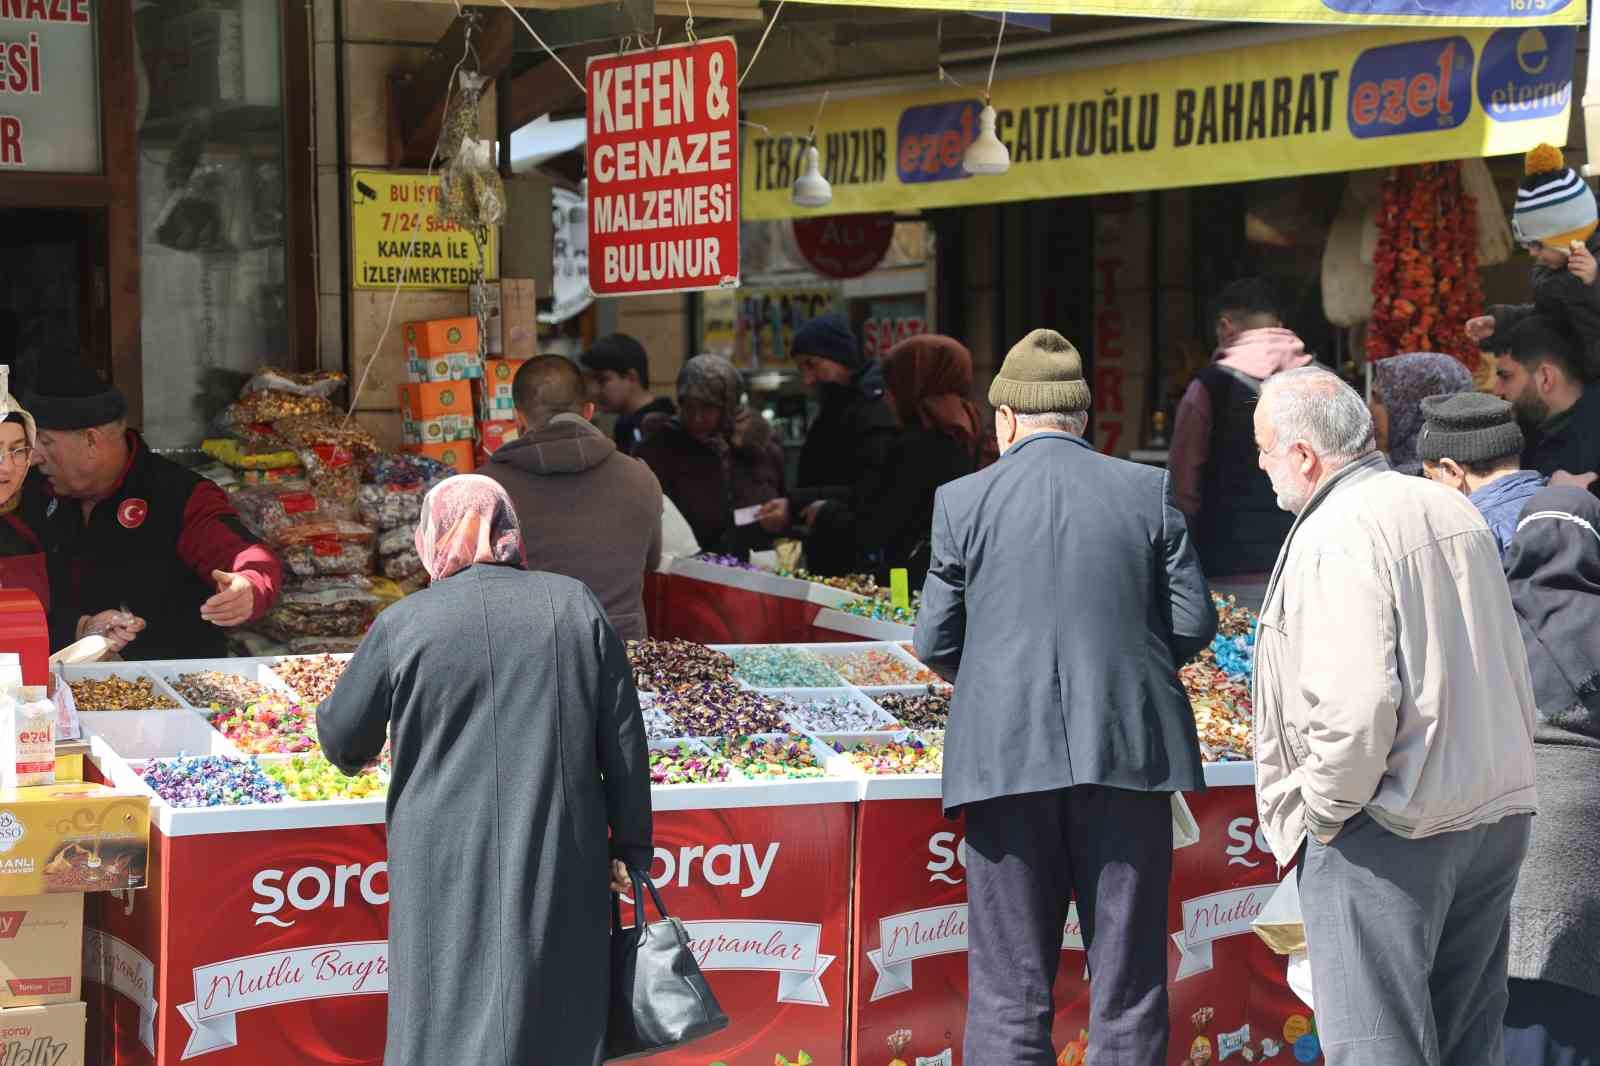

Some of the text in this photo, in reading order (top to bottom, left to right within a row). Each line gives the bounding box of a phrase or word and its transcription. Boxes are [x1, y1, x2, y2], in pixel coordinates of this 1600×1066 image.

[592, 51, 730, 135] KEFEN &
[1173, 71, 1339, 147] BAHARAT
[1351, 41, 1457, 126] ezel
[593, 129, 732, 183] CENAZE
[824, 129, 886, 185] HIZIR
[390, 184, 409, 202] BU
[378, 236, 468, 259] KAMERA İLE
[381, 212, 420, 234] 7/24
[603, 237, 722, 284] BULUNUR
[19, 721, 50, 744] ezel
[647, 842, 780, 898] oray
[887, 910, 968, 957] Mutlu
[204, 956, 304, 1010] Mutlu
